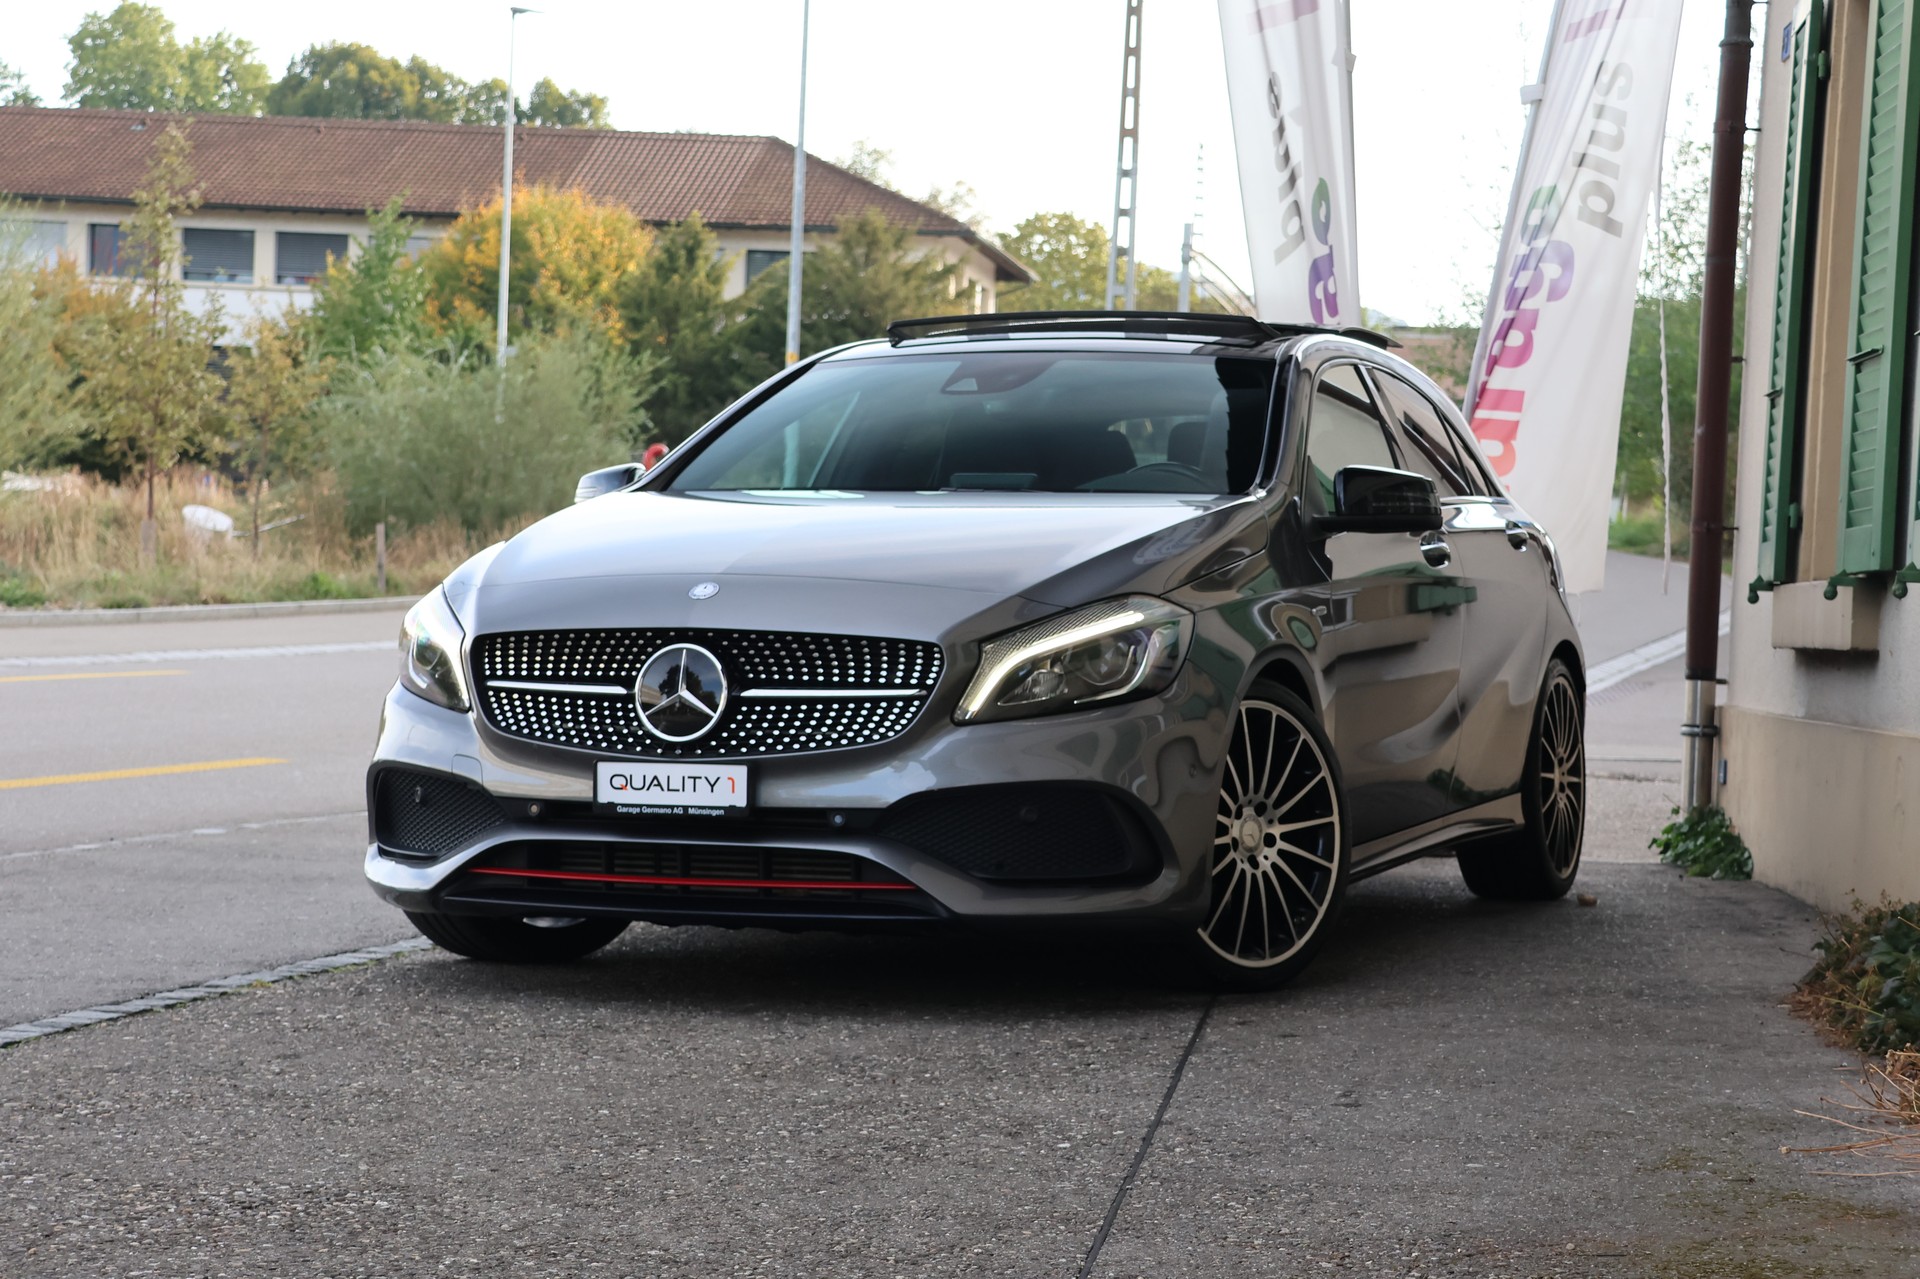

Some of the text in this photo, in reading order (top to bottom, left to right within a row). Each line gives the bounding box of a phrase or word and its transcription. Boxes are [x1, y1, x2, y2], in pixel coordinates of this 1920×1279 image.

[1572, 60, 1634, 239] plus
[1470, 184, 1575, 493] arage
[610, 774, 735, 794] QUALITY 1
[617, 805, 640, 814] Garage
[642, 806, 672, 814] Germano
[688, 807, 725, 815] Münsingen
